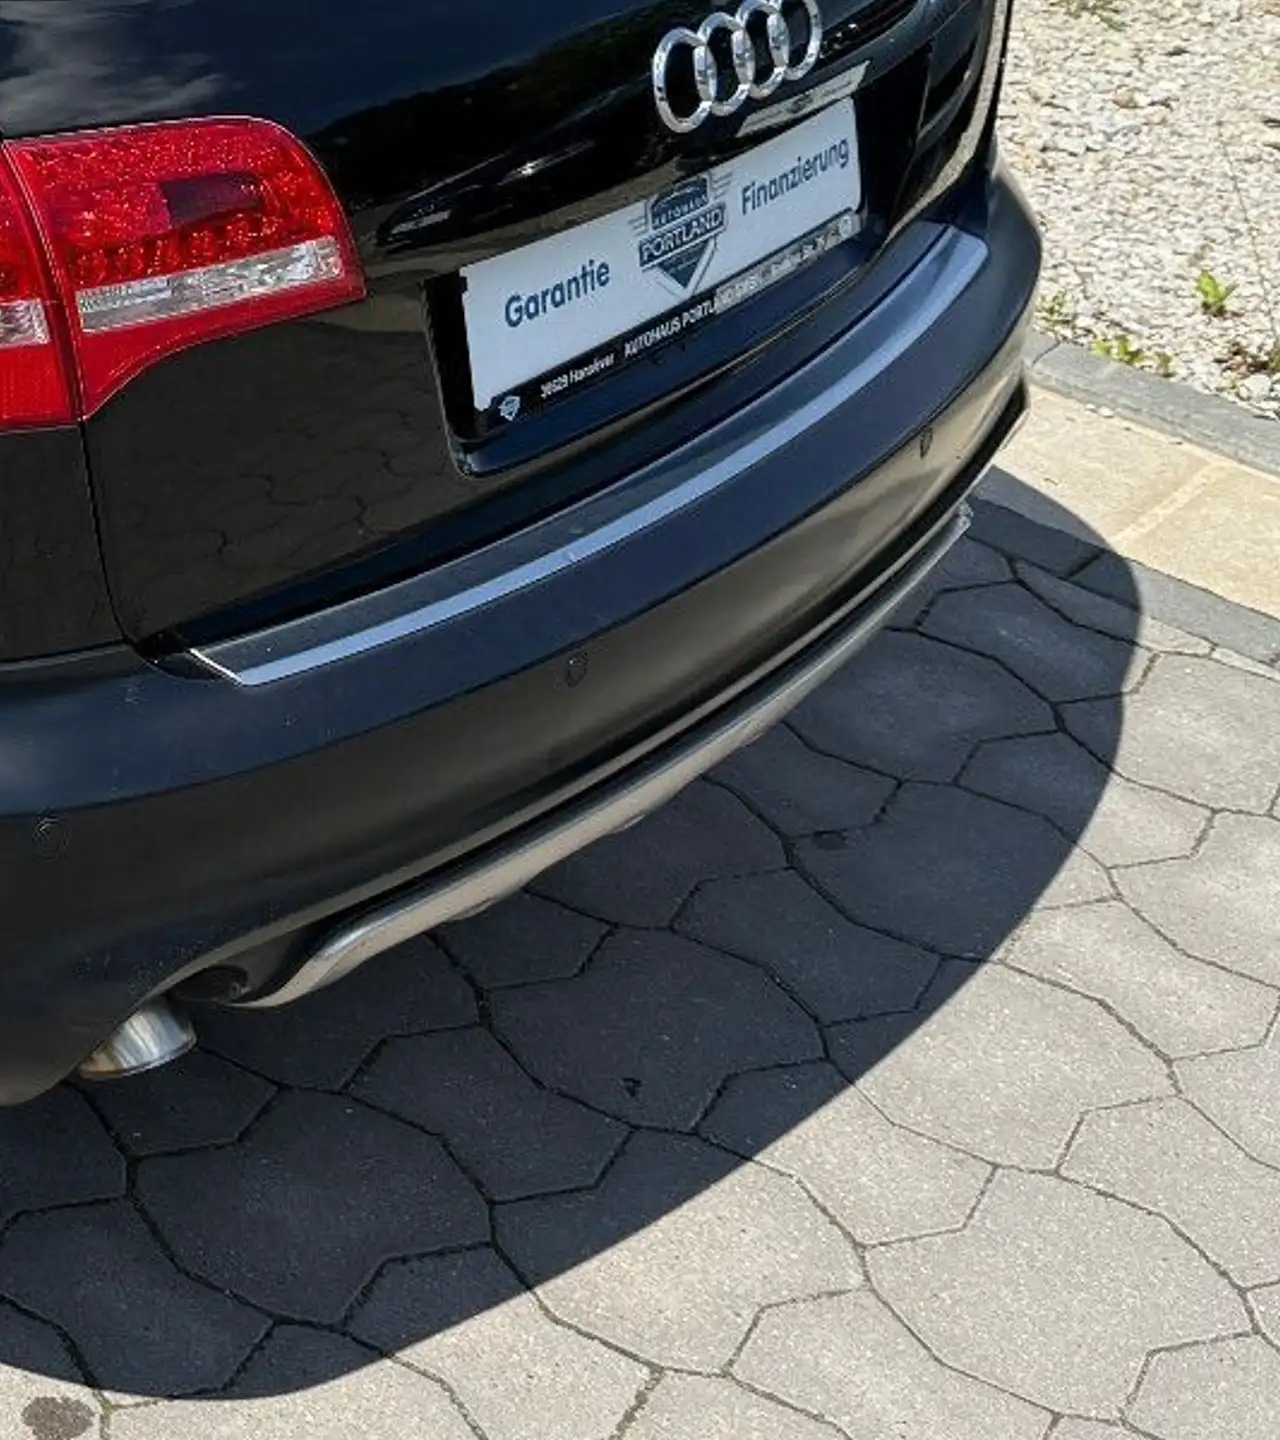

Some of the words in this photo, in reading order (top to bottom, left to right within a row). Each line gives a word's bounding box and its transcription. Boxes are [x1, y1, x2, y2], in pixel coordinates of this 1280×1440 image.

[741, 138, 849, 216] Finanzierung
[641, 208, 722, 261] PORTLAND
[503, 260, 610, 328] Garantie
[624, 316, 681, 357] AUTOHAUS
